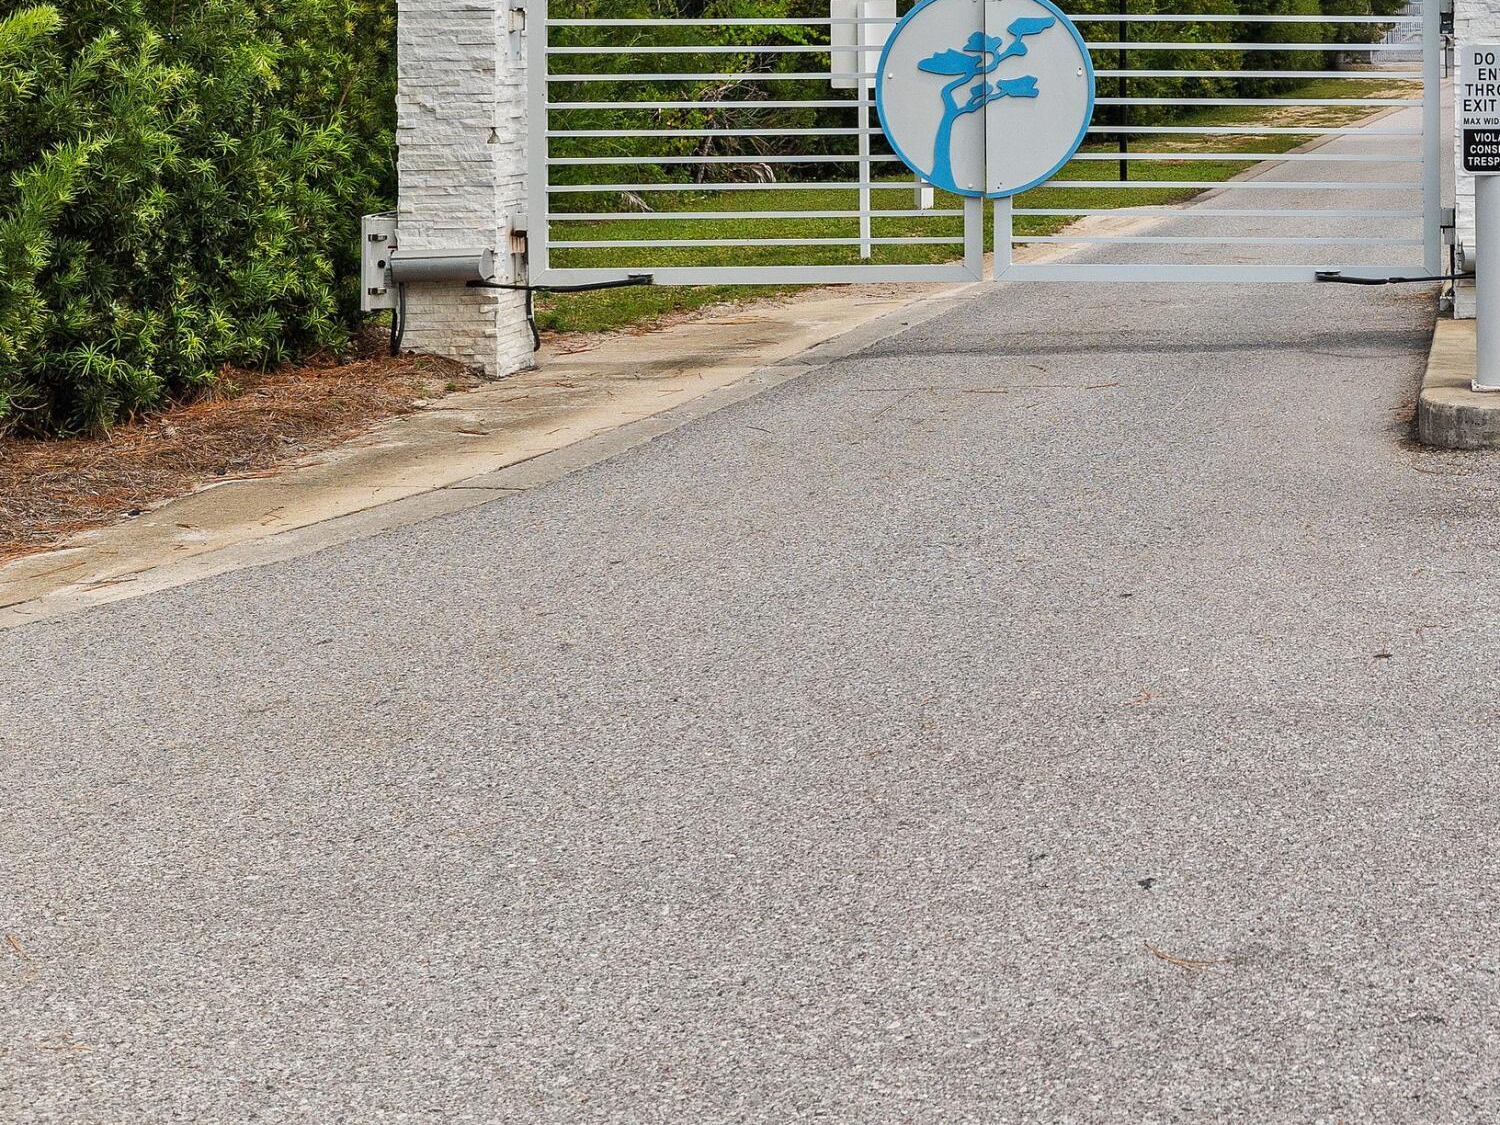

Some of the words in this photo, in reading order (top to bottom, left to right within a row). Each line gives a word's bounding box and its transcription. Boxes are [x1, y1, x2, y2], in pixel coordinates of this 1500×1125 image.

[1474, 52, 1495, 65] DO
[1463, 99, 1497, 112] EXIT
[1463, 117, 1481, 125] MAX
